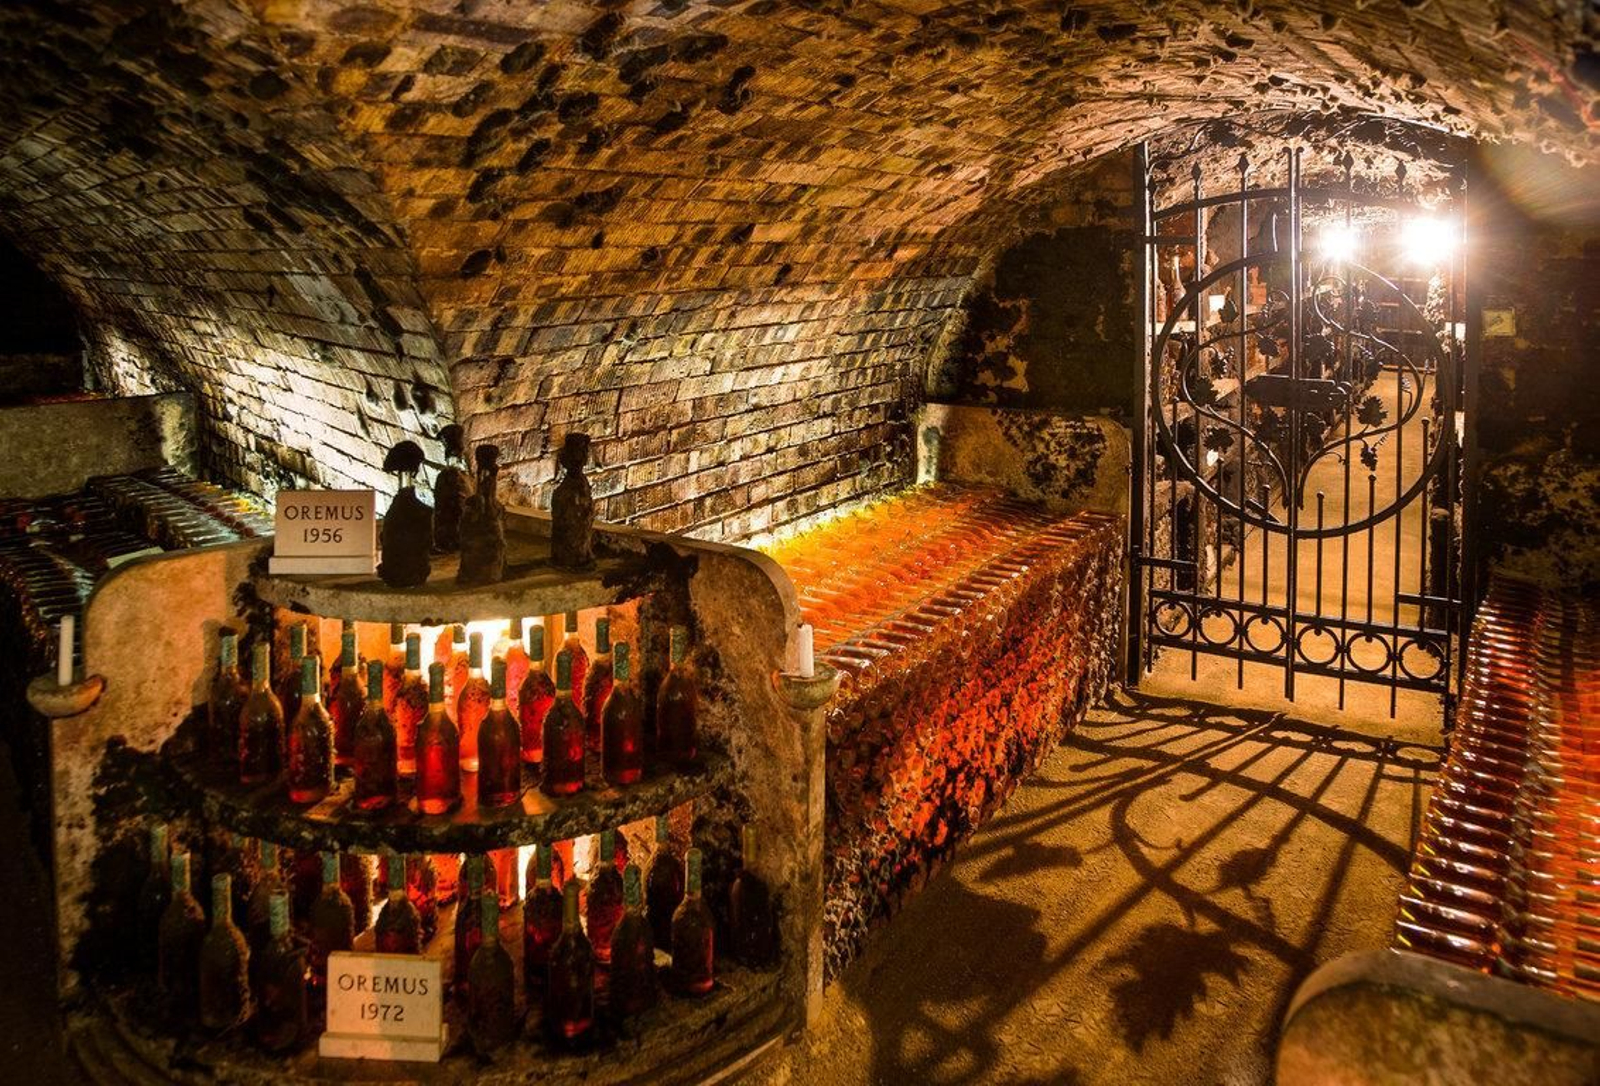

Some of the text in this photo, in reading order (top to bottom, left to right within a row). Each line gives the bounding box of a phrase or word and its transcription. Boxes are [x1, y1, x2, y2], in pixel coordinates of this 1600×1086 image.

[284, 505, 364, 521] OREMUS
[303, 528, 343, 543] 1956
[338, 973, 429, 995] OREMUS
[361, 1003, 404, 1022] 1972
